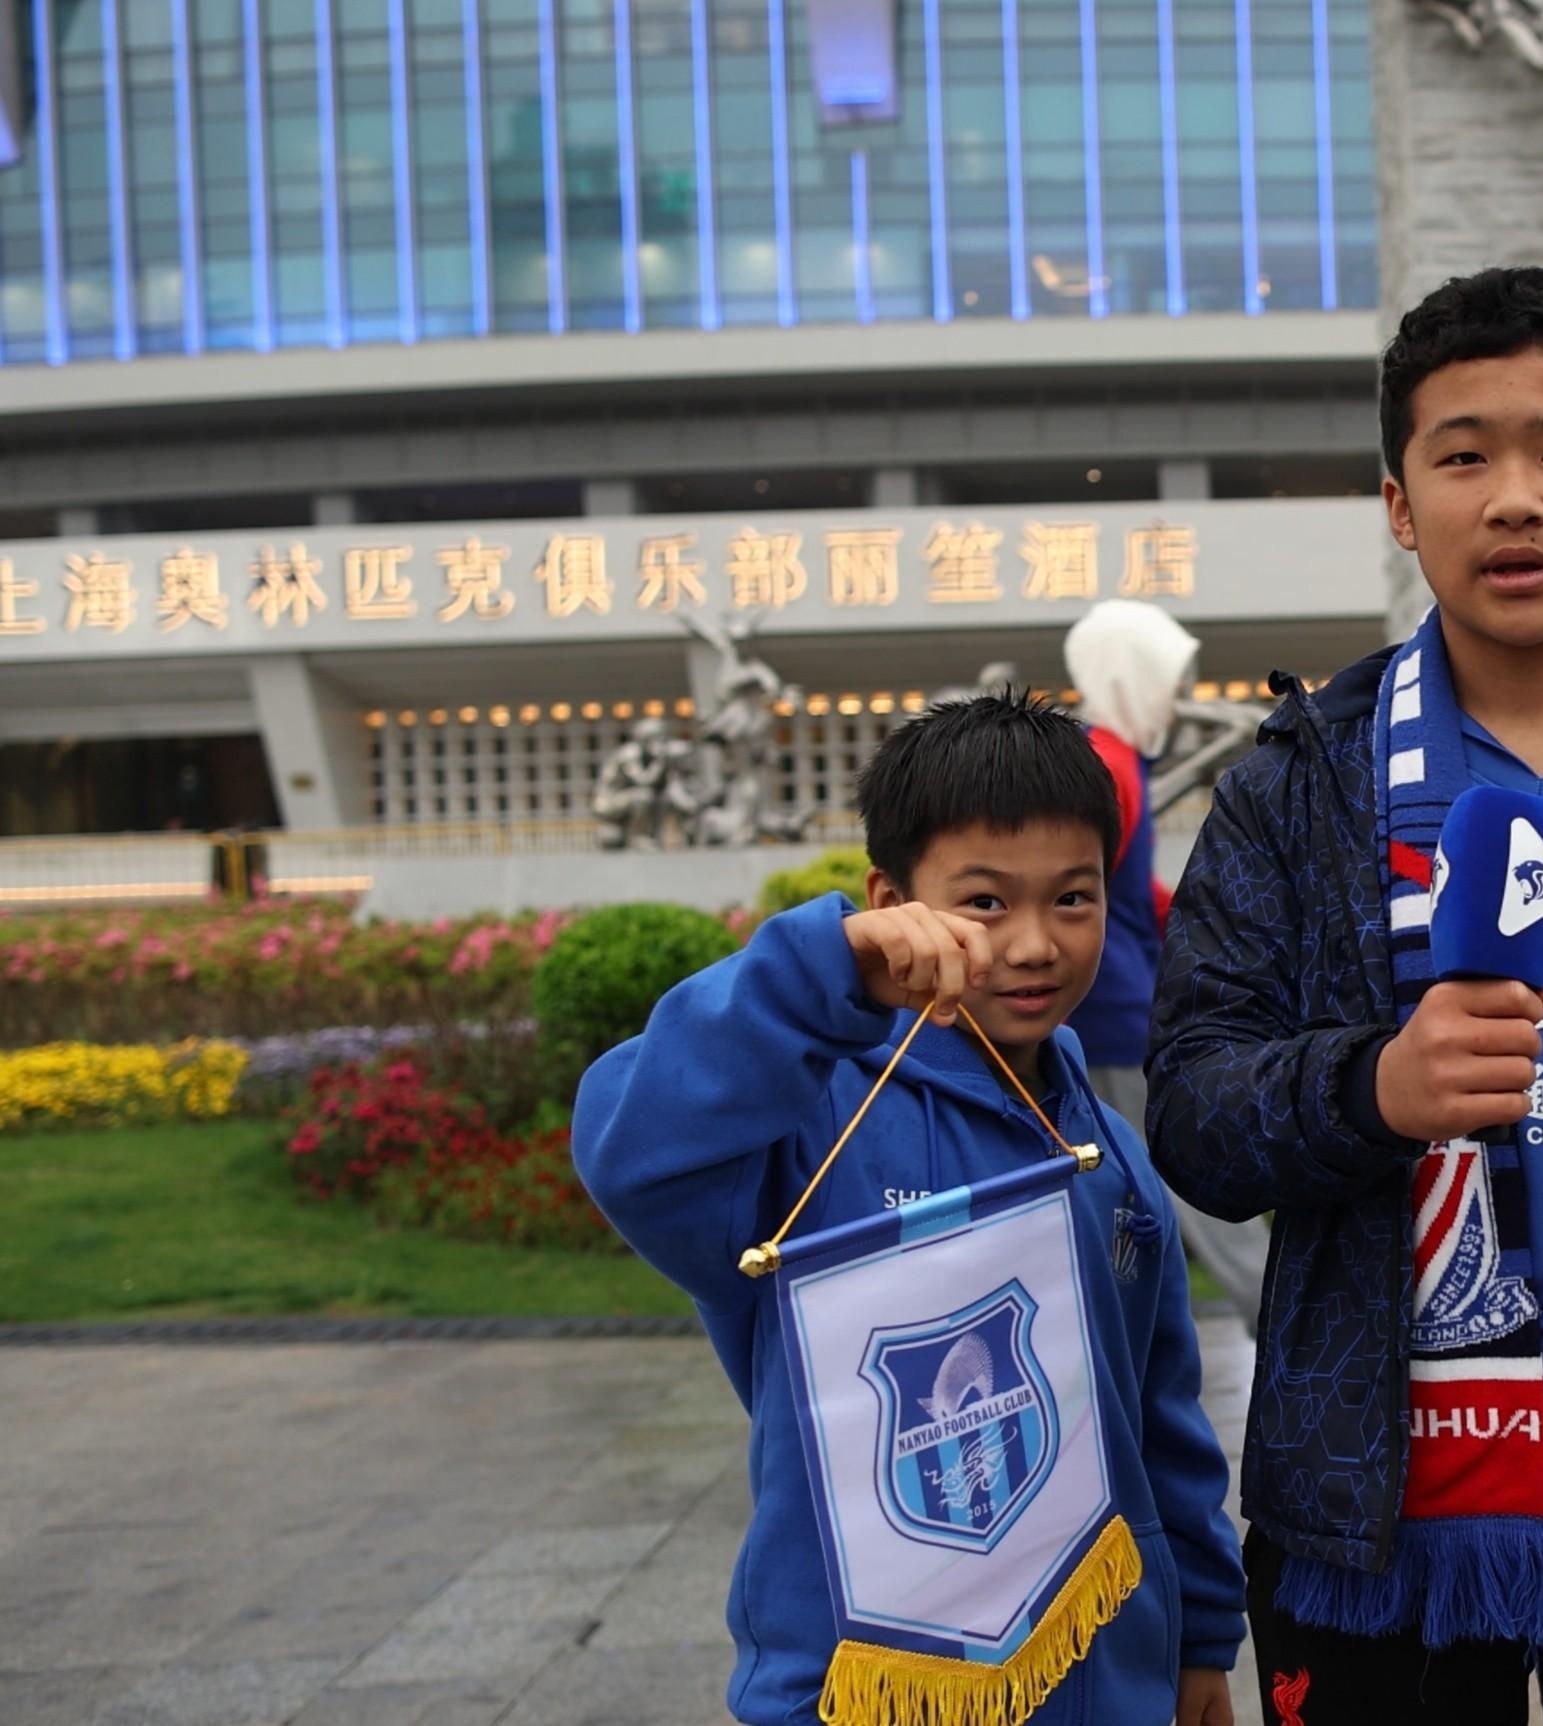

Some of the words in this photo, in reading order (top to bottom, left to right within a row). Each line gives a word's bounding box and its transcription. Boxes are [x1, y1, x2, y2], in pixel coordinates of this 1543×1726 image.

[898, 1427, 943, 1452] NANYAO
[944, 1403, 1002, 1437] FOOTBALL
[1004, 1389, 1033, 1413] CLUB
